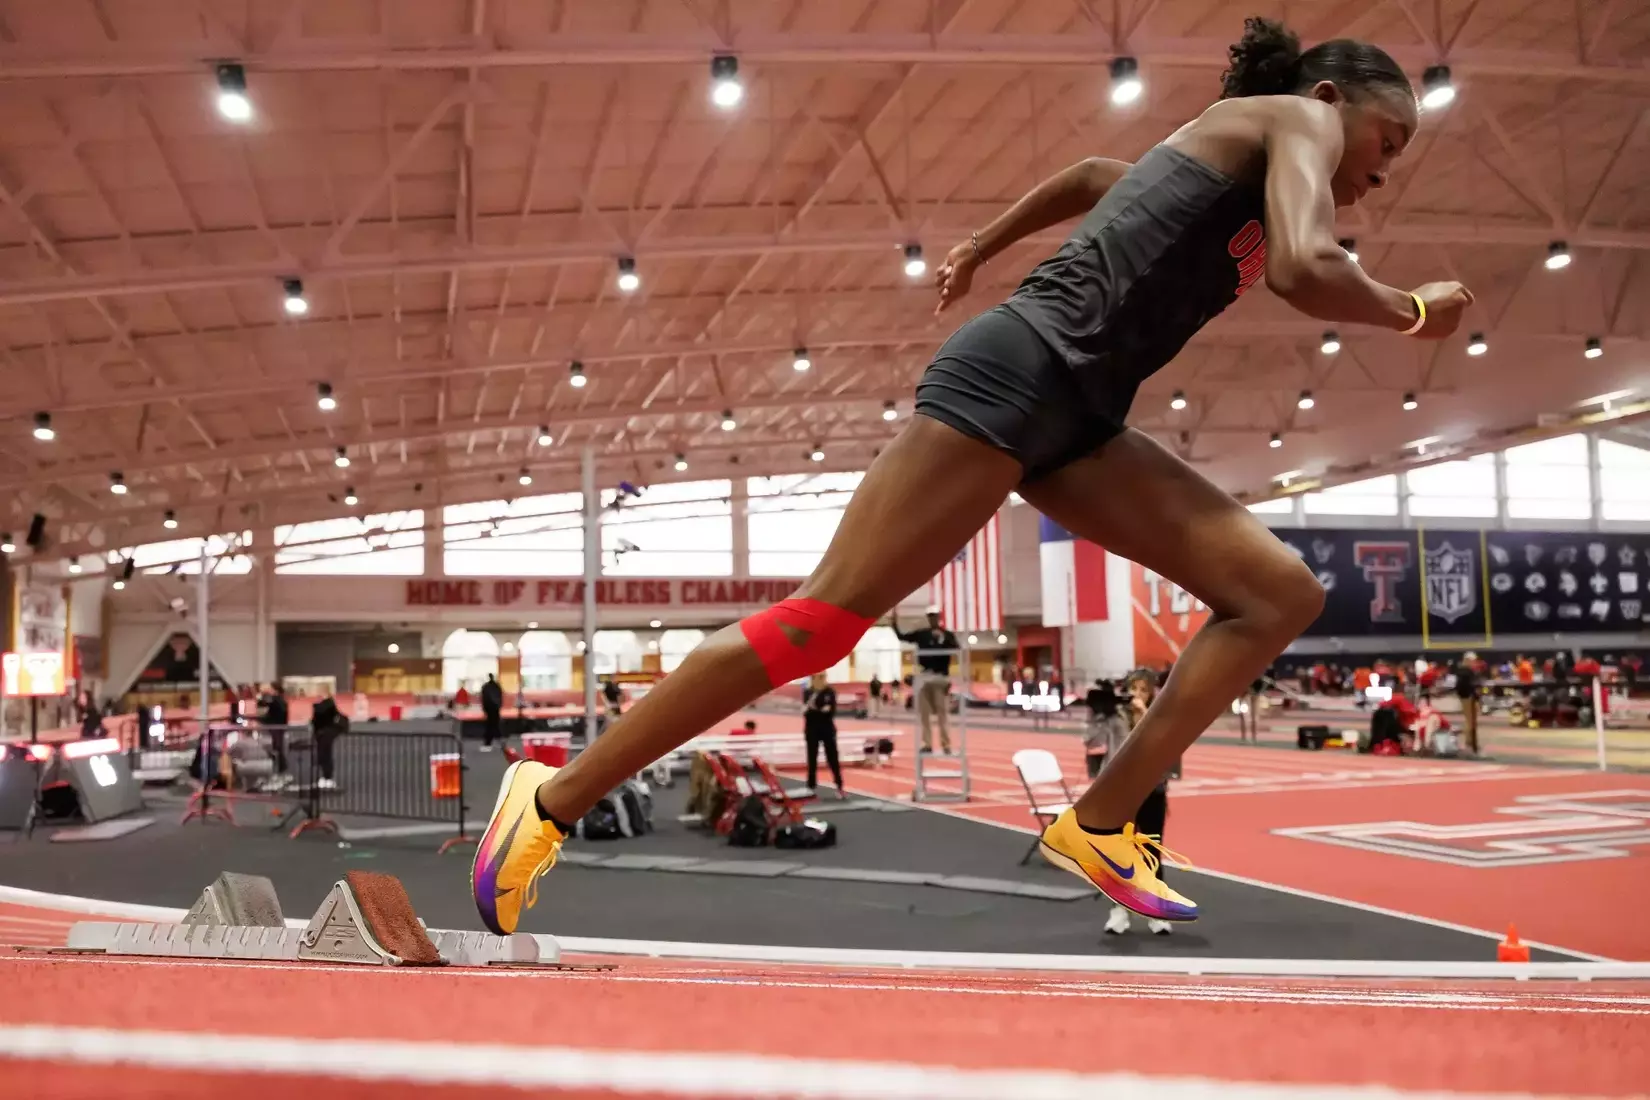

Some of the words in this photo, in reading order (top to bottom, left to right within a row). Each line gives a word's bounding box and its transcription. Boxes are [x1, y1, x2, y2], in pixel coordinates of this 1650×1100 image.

[406, 580, 482, 605] HOME
[494, 580, 525, 605] OF
[537, 580, 670, 604] FEARLESS
[1426, 575, 1470, 610] NFL
